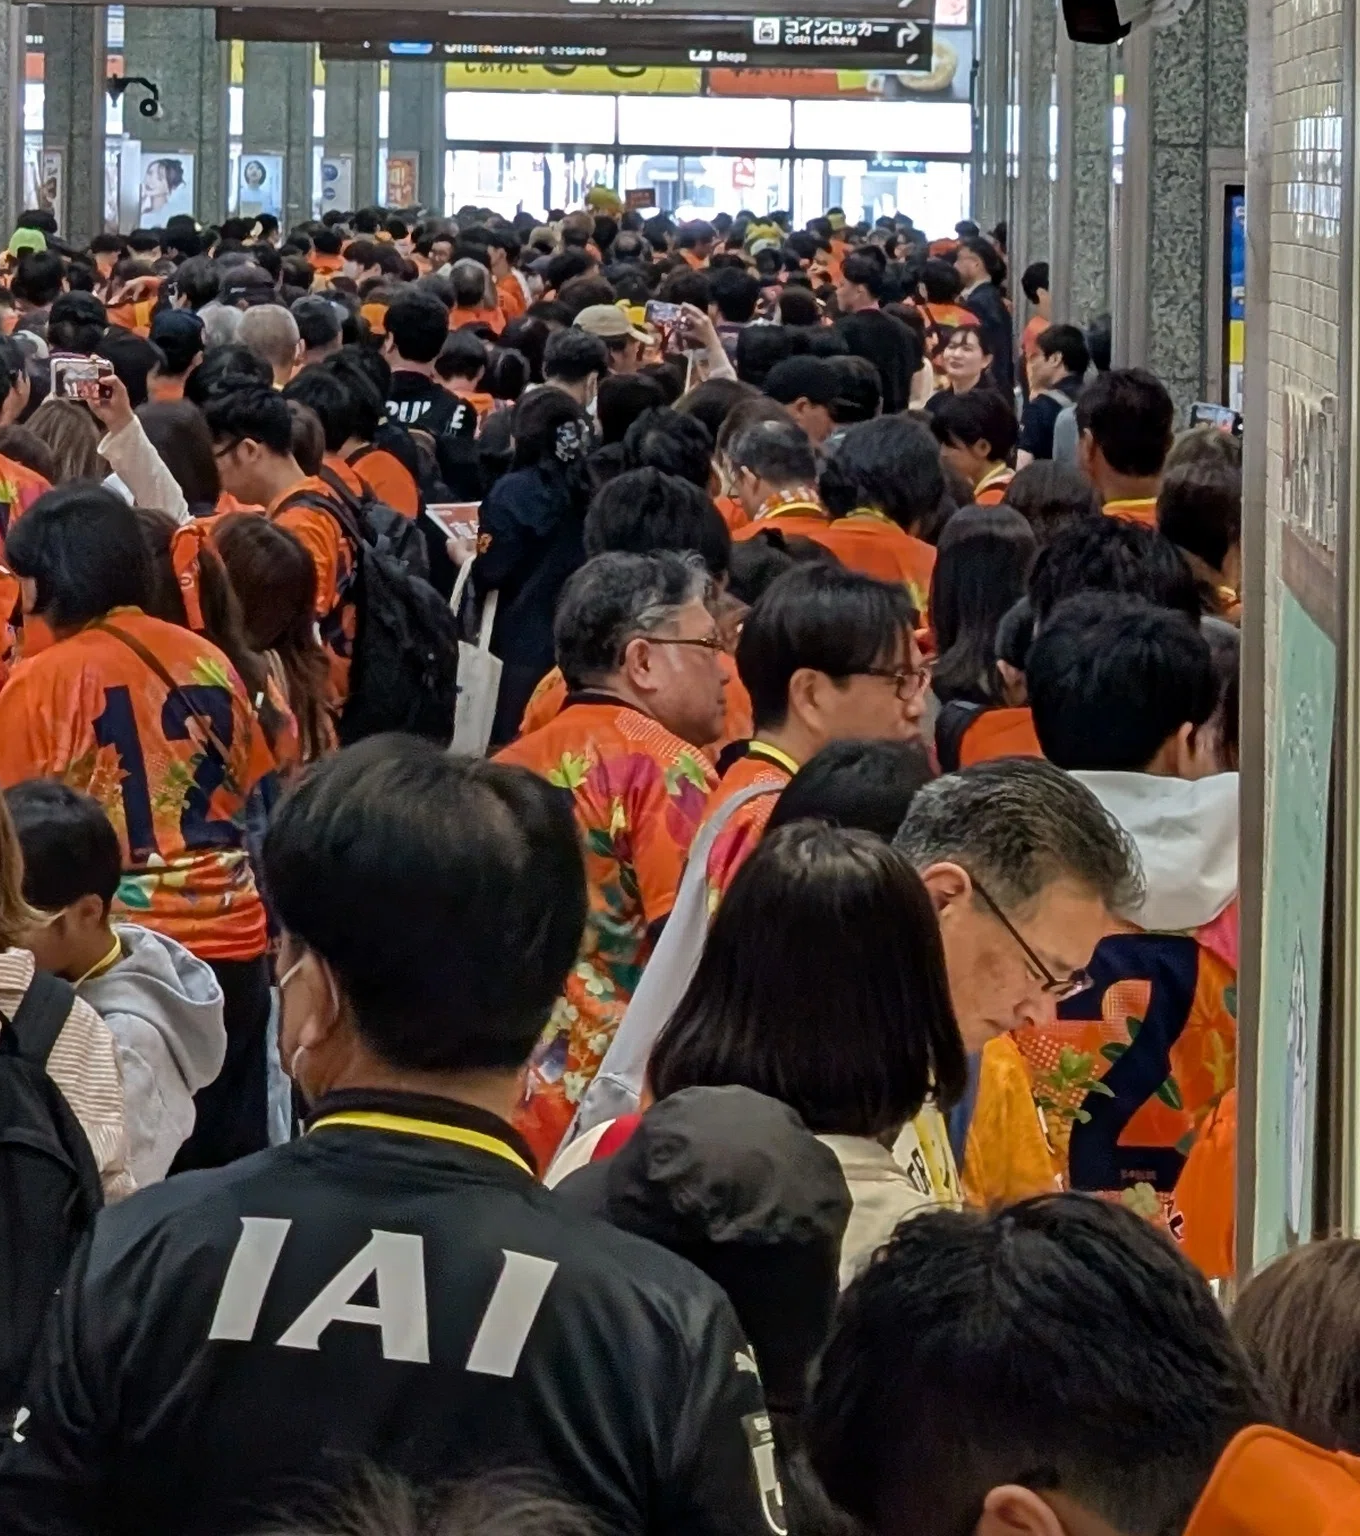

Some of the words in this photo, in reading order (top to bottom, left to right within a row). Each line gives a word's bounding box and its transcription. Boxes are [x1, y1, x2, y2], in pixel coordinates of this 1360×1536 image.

[784, 19, 890, 36] コインロッカー
[208, 1216, 559, 1379] IAI
